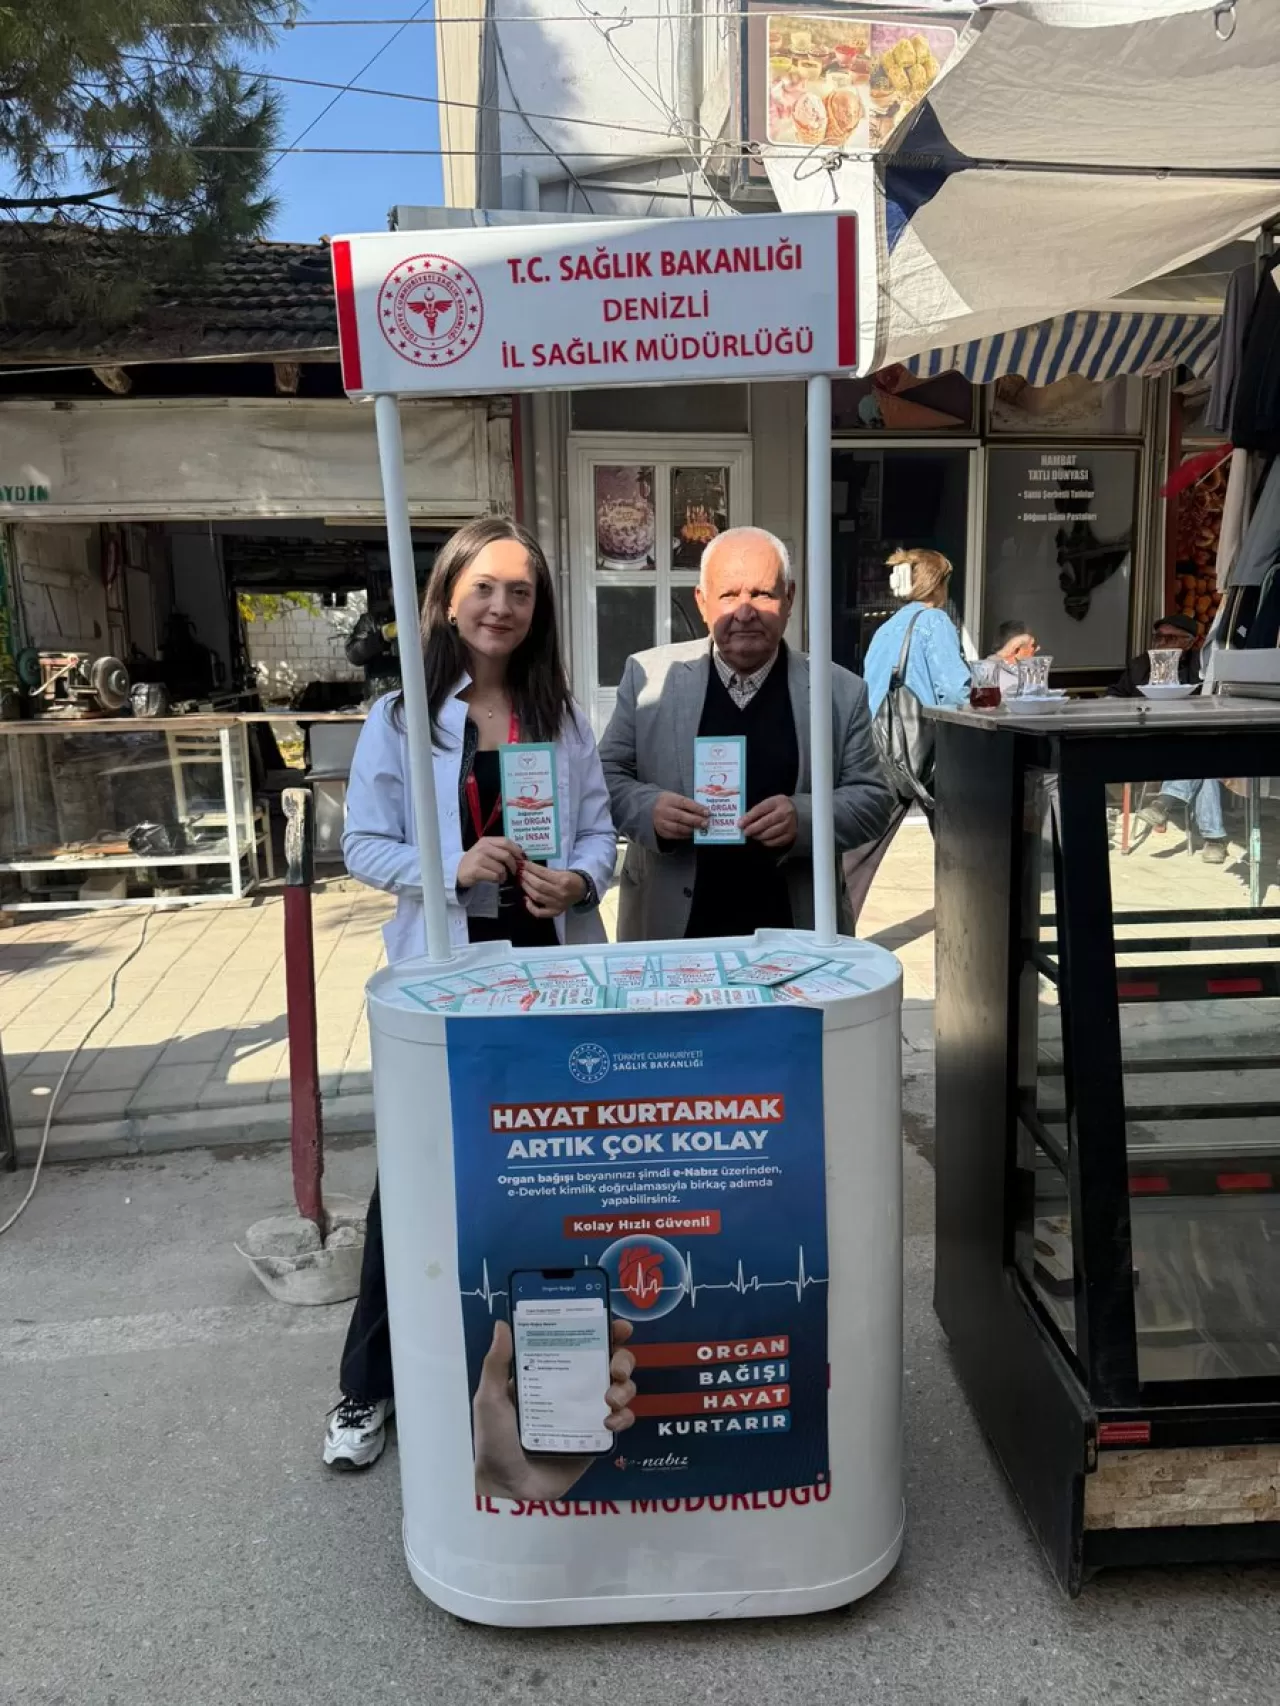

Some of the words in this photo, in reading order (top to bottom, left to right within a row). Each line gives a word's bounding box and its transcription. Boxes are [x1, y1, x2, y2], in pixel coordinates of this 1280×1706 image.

[507, 256, 550, 284] T.C.
[559, 246, 653, 281] SAĞLIK
[660, 236, 802, 276] BAKANLIĞI
[603, 289, 709, 322] DENİZLİ
[501, 341, 525, 368] İL
[532, 338, 629, 367] SAĞLIK
[636, 327, 814, 362] MÜDÜRLÜĞÜ
[1028, 469, 1050, 481] TATLI
[1051, 467, 1089, 480] DÜNYASI
[0, 484, 48, 502] YDIN
[711, 804, 738, 812] ORGAN
[524, 816, 551, 826] ORGAN
[525, 832, 550, 841] İNSAN
[612, 1060, 648, 1071] SAĞLIK
[650, 1058, 704, 1070] BAKANLIĞI
[613, 1052, 645, 1062] TÜRKİYE
[648, 1049, 704, 1060] CUMHURİYETİ
[493, 1106, 590, 1130] HAYAT
[597, 1098, 781, 1126] KURTARMAK
[507, 1136, 596, 1160] ARTIK
[602, 1133, 664, 1161] ÇOK
[672, 1129, 769, 1153] KOLAY
[498, 1175, 535, 1187] Organ
[538, 1173, 574, 1185] bağışı
[576, 1171, 636, 1184] beyanınızı
[638, 1168, 670, 1181] şimdi
[673, 1166, 719, 1177] e-Nabız
[721, 1165, 782, 1176] üzerinden,
[507, 1186, 557, 1198] e-Devlet
[559, 1183, 597, 1195] kimlik
[598, 1180, 688, 1194] doğrulamasıyla
[690, 1179, 727, 1191] birkaç
[729, 1177, 773, 1188] adımda
[601, 1192, 681, 1208] yapabilirsiniz.
[573, 1220, 614, 1233] Kolay
[618, 1218, 651, 1231] Hızlı
[655, 1215, 710, 1229] Güvenli
[697, 1339, 786, 1361] ORGAN
[699, 1363, 786, 1385] BAĞIŞI
[703, 1388, 786, 1409] HAYAT
[658, 1415, 787, 1436] KURTARIR
[629, 1452, 689, 1467] -nabız
